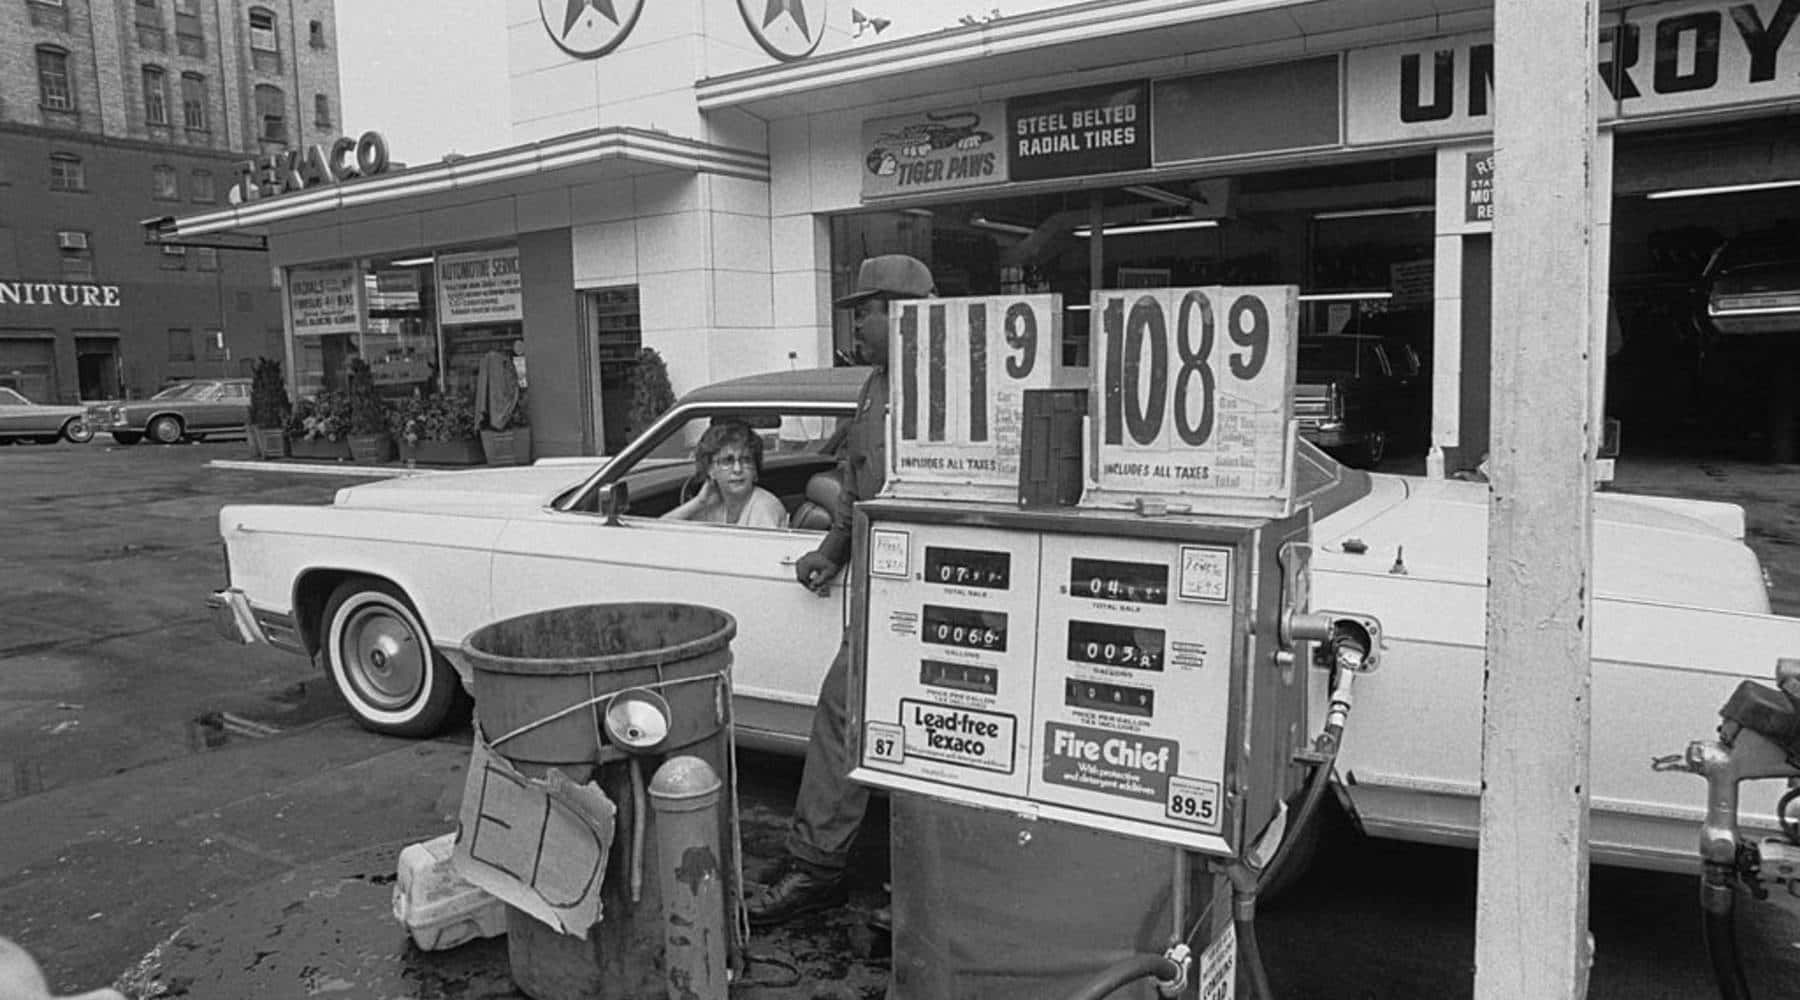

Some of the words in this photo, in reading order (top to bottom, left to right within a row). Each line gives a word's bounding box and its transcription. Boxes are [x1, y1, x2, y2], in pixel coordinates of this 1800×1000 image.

[1401, 0, 1800, 123] UNROY
[1017, 114, 1067, 136] STEEL
[1073, 104, 1136, 128] BELTED
[1019, 133, 1080, 157] RADIAL
[1084, 127, 1136, 149] TIRES
[231, 131, 389, 202] TEXACO
[899, 158, 945, 186] TIGER
[947, 152, 996, 179] PAWS
[0, 282, 120, 307] NITURE
[899, 303, 988, 443] 111
[1004, 302, 1037, 379] 9
[1104, 289, 1215, 447] 108
[1228, 294, 1269, 380] 9
[901, 457, 944, 470] INCLUDES
[947, 458, 964, 470] ALL
[967, 459, 996, 473] TAXES
[1104, 463, 1149, 477] INCLUDES
[1152, 465, 1171, 478] ALL
[1174, 465, 1209, 480] TAXES
[915, 706, 999, 738] Lead-free
[875, 738, 894, 756] 87
[926, 727, 985, 756] Texaco
[1054, 728, 1100, 761] Fire
[1103, 738, 1169, 772] Chief
[1171, 795, 1212, 818] 89.5
